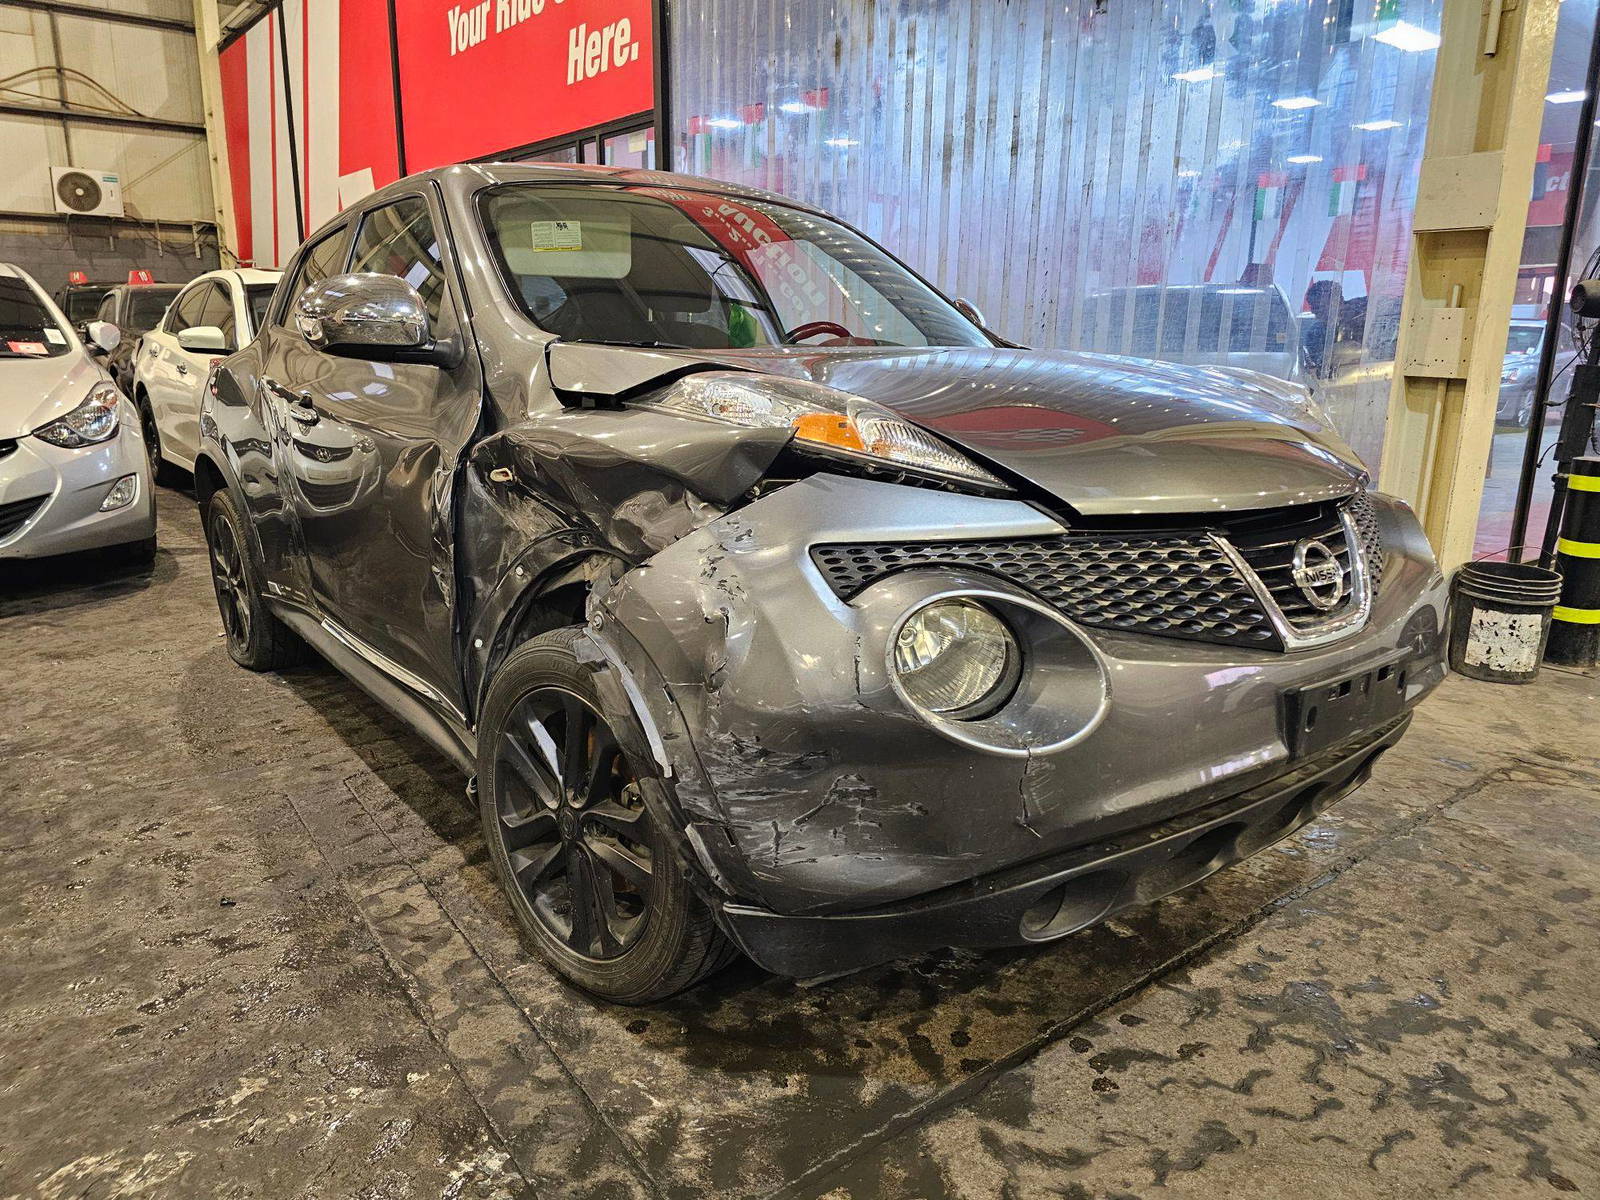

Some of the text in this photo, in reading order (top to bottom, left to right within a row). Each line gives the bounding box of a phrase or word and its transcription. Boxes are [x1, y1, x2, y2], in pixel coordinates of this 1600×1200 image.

[447, 1, 491, 57] Your
[566, 17, 639, 86] Here.
[1304, 566, 1338, 583] NISS
